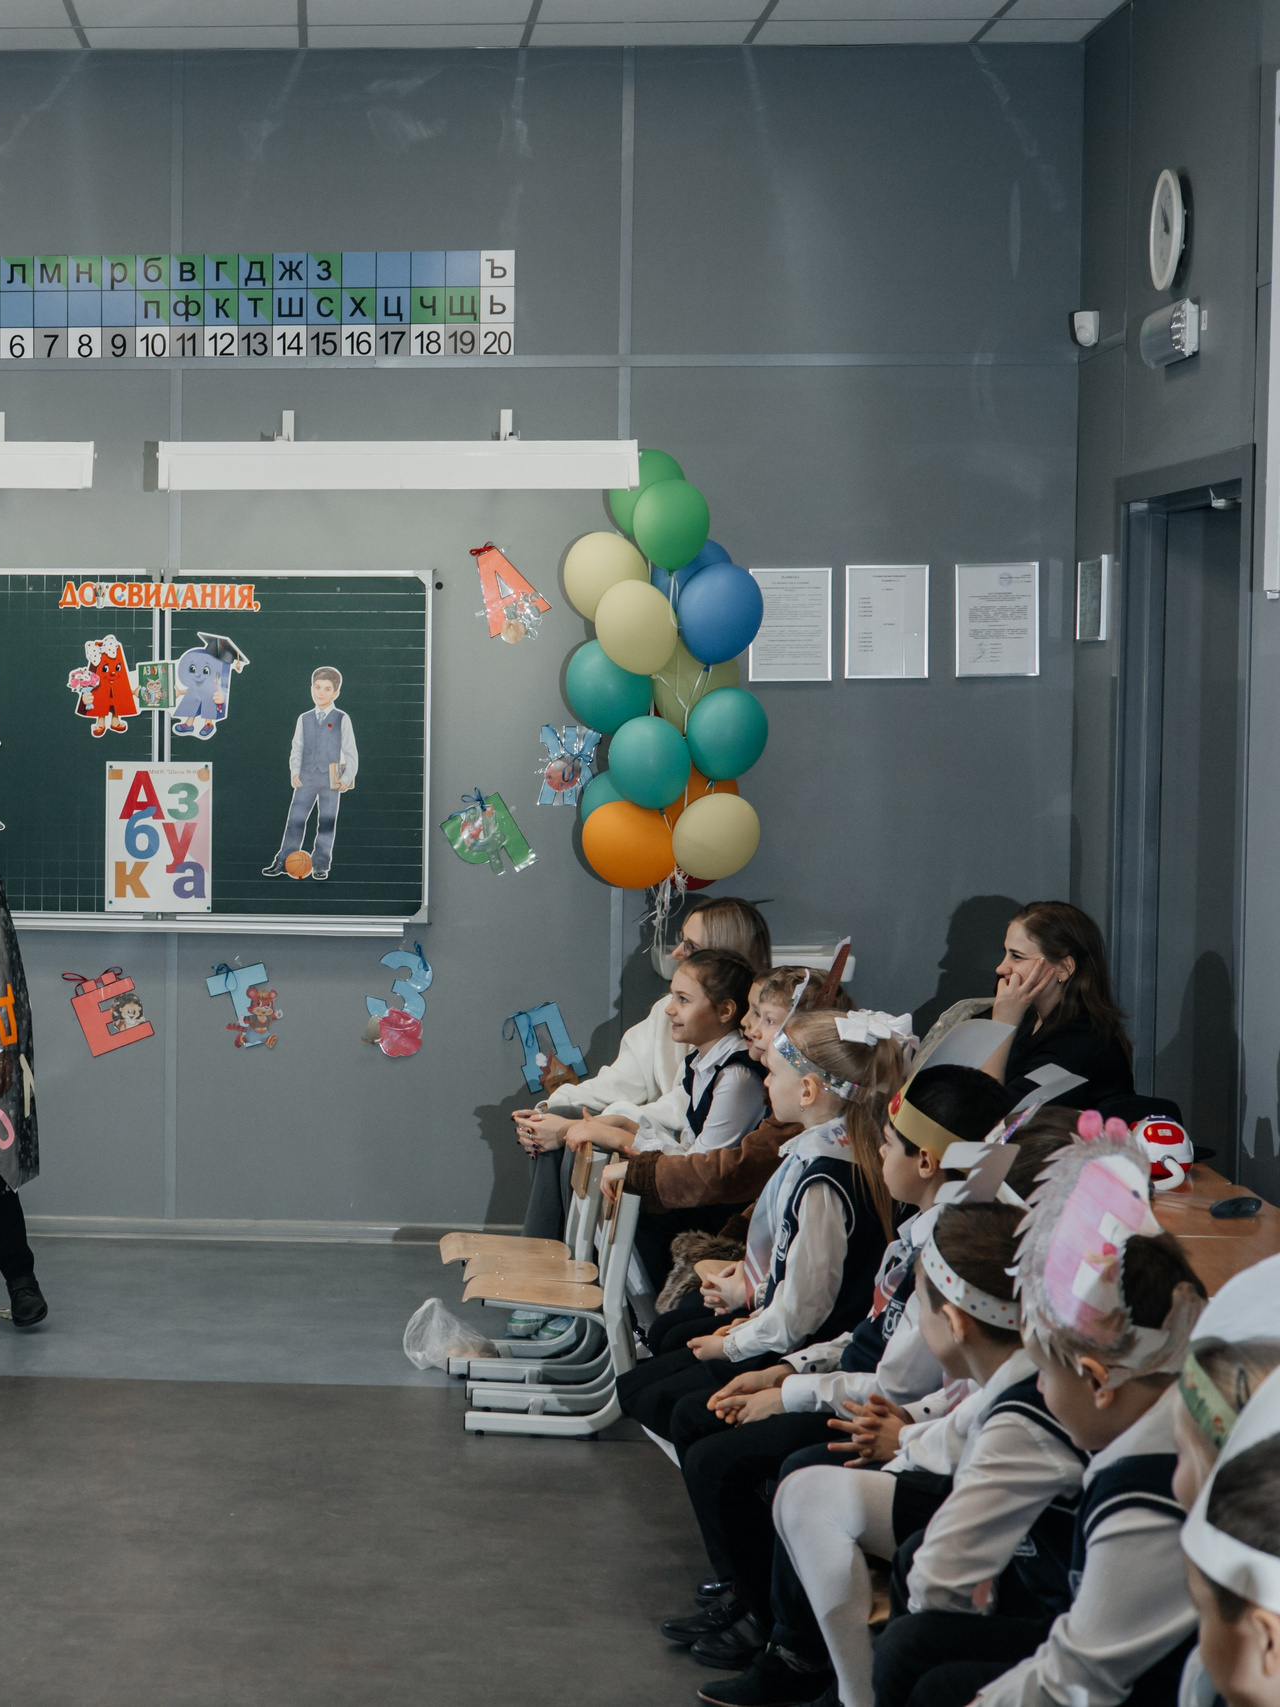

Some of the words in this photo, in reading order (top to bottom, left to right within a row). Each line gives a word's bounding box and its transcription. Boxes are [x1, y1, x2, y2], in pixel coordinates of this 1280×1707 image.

[6, 263, 26, 284] л
[40, 263, 61, 284] м
[75, 262, 93, 284] н
[110, 262, 128, 290] р
[143, 256, 163, 283] б
[179, 261, 196, 282] в
[215, 261, 228, 282] г
[244, 260, 266, 287] д
[278, 260, 304, 281] ж
[316, 259, 332, 281] з
[485, 258, 507, 279] ъ
[144, 300, 161, 319] п
[173, 294, 202, 322] ф
[215, 297, 230, 318] к
[247, 297, 264, 318] т
[277, 296, 304, 318] ш
[316, 296, 334, 318] с
[349, 296, 367, 317] х
[384, 295, 403, 322] ц
[419, 295, 437, 316] ч
[449, 295, 478, 322] щ
[489, 294, 507, 315] ь
[9, 334, 25, 359] 6
[43, 334, 59, 358] 7
[77, 334, 93, 358] 8
[110, 333, 127, 358] 9
[140, 333, 167, 358] 10
[176, 332, 196, 357] 11
[208, 332, 235, 357] 12
[241, 332, 268, 357] 13
[276, 331, 304, 356] 14
[310, 331, 338, 356] 15
[345, 331, 372, 356] 16
[379, 330, 407, 355] 17
[414, 330, 442, 355] 18
[448, 330, 476, 355] 19
[482, 330, 512, 355] 20
[58, 581, 97, 608] ДО
[108, 583, 261, 612] СВИДАНИЯ,
[477, 546, 552, 638] А
